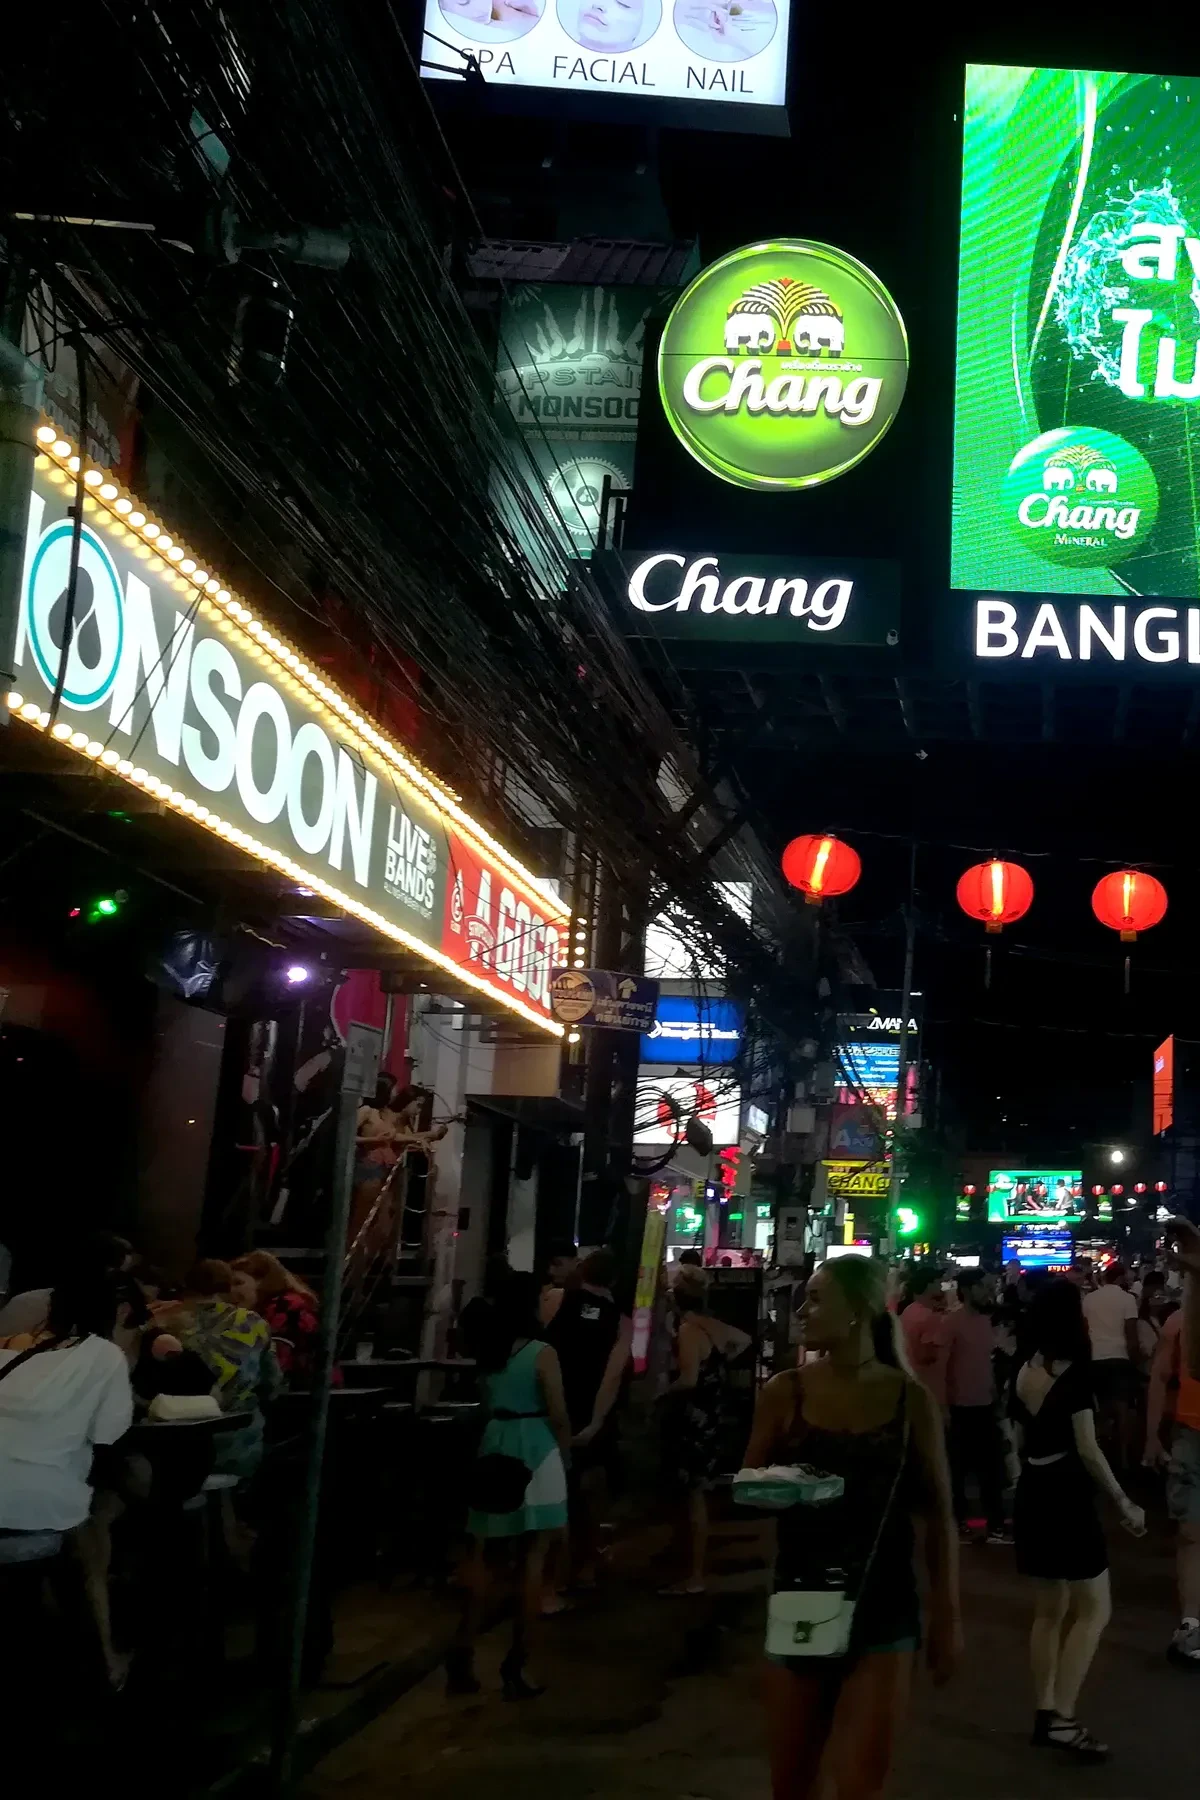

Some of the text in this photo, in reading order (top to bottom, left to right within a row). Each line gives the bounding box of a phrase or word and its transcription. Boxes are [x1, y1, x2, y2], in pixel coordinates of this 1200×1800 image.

[553, 55, 656, 87] FACIAL
[686, 66, 754, 94] NAIL
[500, 366, 643, 395] UPSTAI
[682, 356, 885, 427] Chang
[1017, 493, 1142, 540] Chang
[628, 554, 853, 630] Chang
[387, 804, 430, 874] LIVE
[384, 848, 435, 909] BANDS
